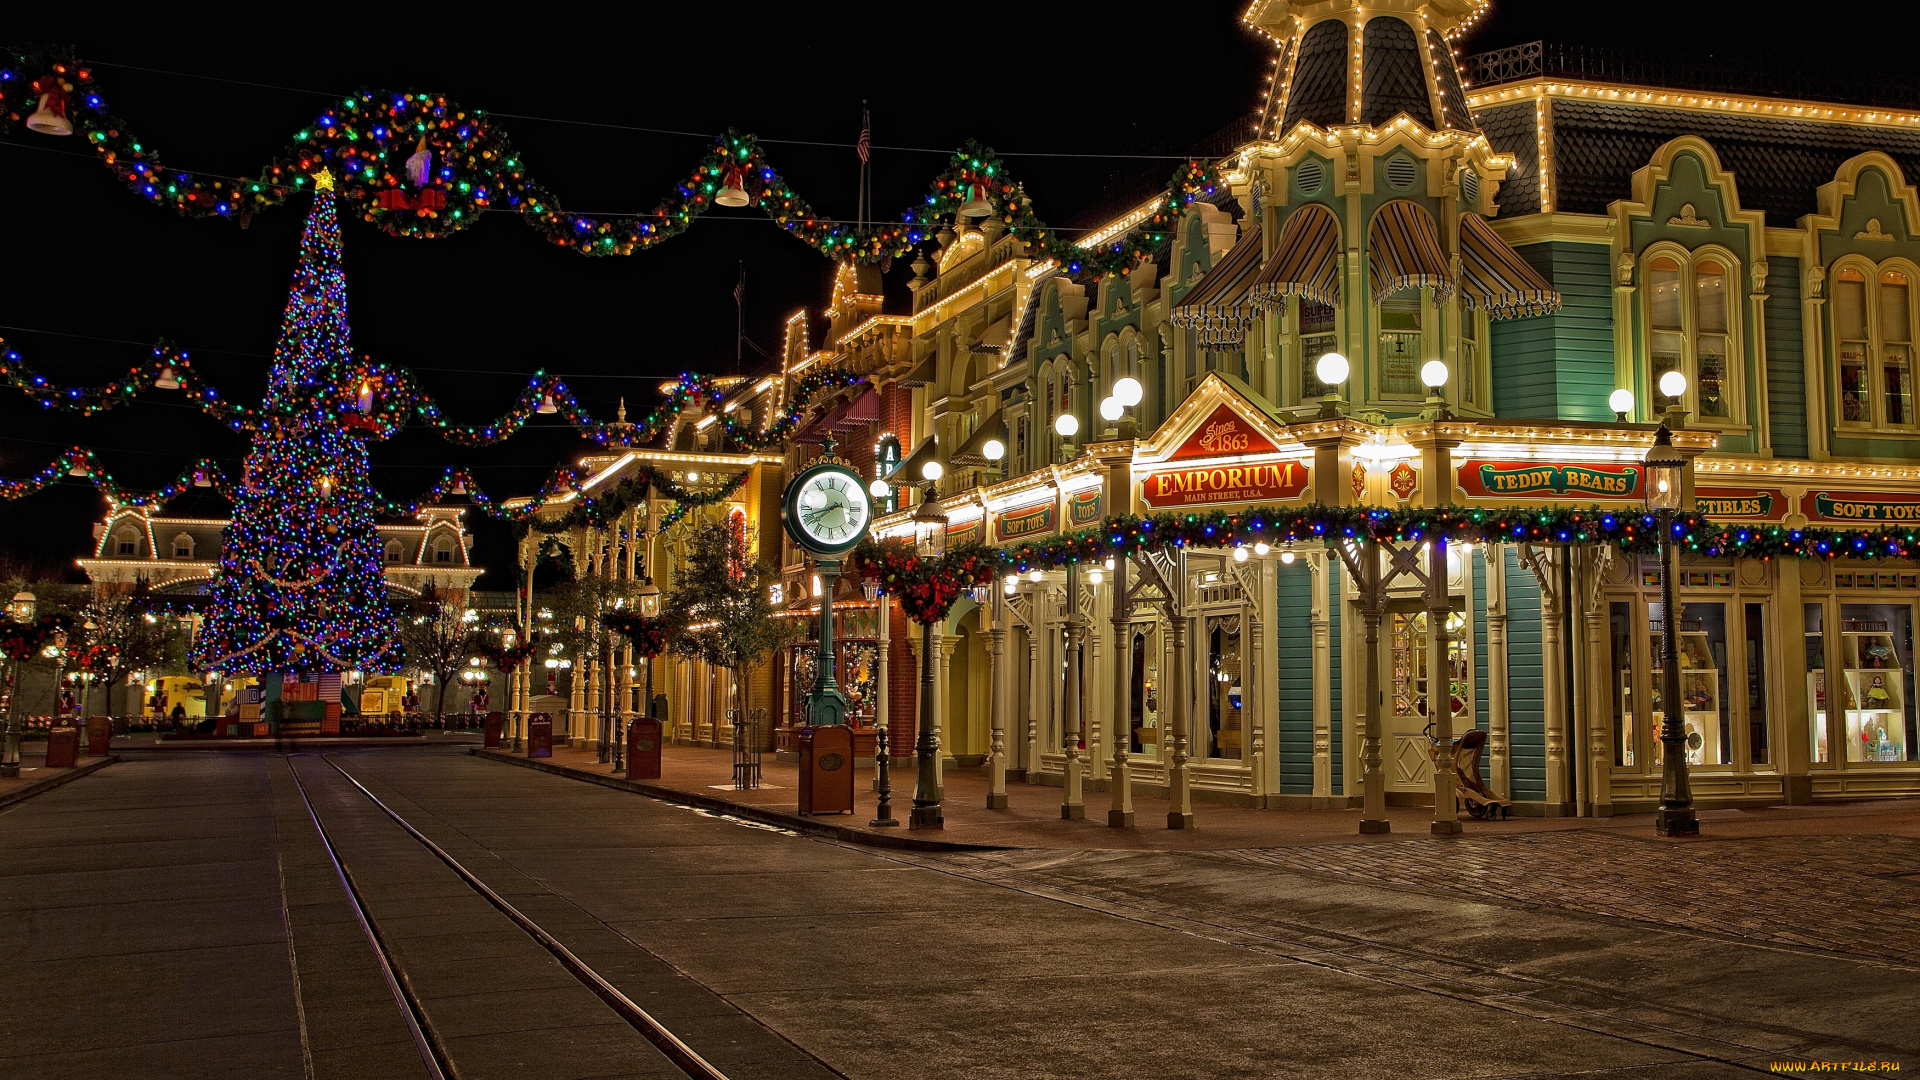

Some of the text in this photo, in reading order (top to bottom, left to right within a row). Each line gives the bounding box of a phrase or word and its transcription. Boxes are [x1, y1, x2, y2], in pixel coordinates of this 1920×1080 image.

[1305, 304, 1335, 317] SUPER
[1305, 315, 1335, 325] STRUCTURES
[1200, 420, 1237, 446] Since
[1216, 433, 1249, 451] 1863
[1156, 464, 1294, 497] EMPORIUM
[1494, 470, 1627, 492] TEDDY BEARS
[1184, 492, 1206, 502] MAIN
[1208, 490, 1240, 501] STREET,
[1077, 502, 1096, 518] TOYS
[1833, 502, 1878, 518] SOFT
[1006, 514, 1045, 534] SOFT TOYS
